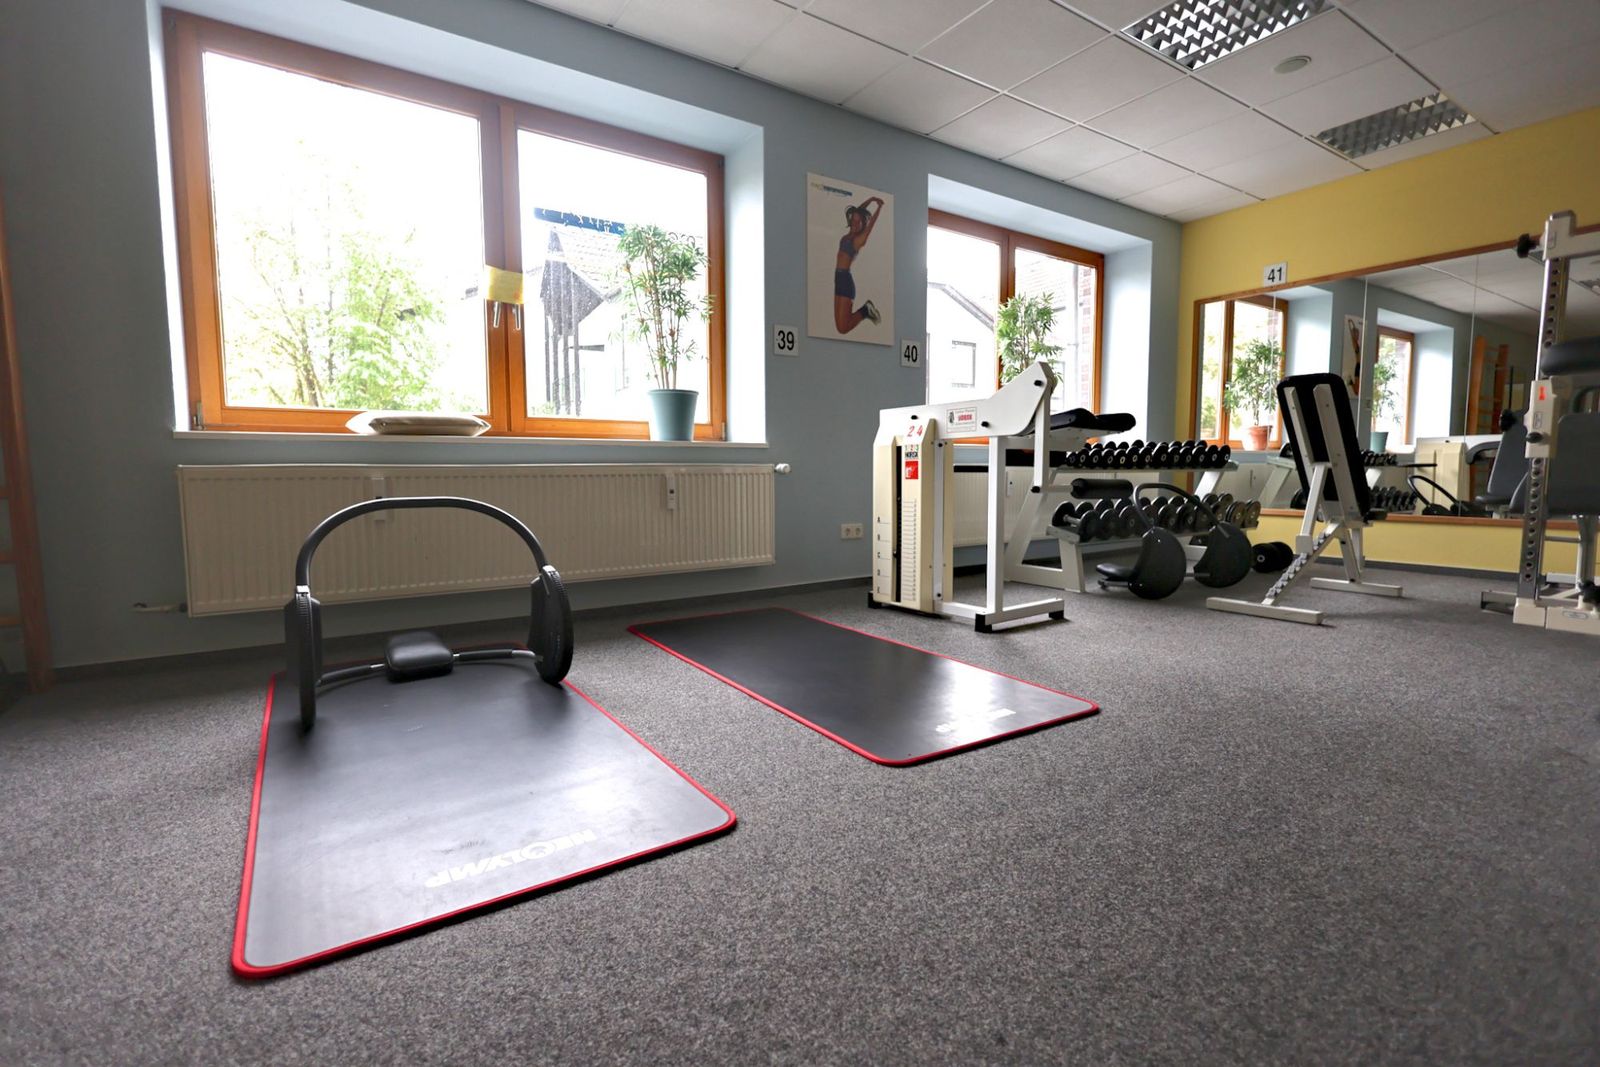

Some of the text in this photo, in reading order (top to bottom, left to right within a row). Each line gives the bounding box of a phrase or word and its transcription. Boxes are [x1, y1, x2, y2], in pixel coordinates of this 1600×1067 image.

[1267, 266, 1282, 282] 41
[777, 330, 795, 350] 39
[903, 345, 918, 362] 40
[425, 829, 597, 888] NEOLYMP
